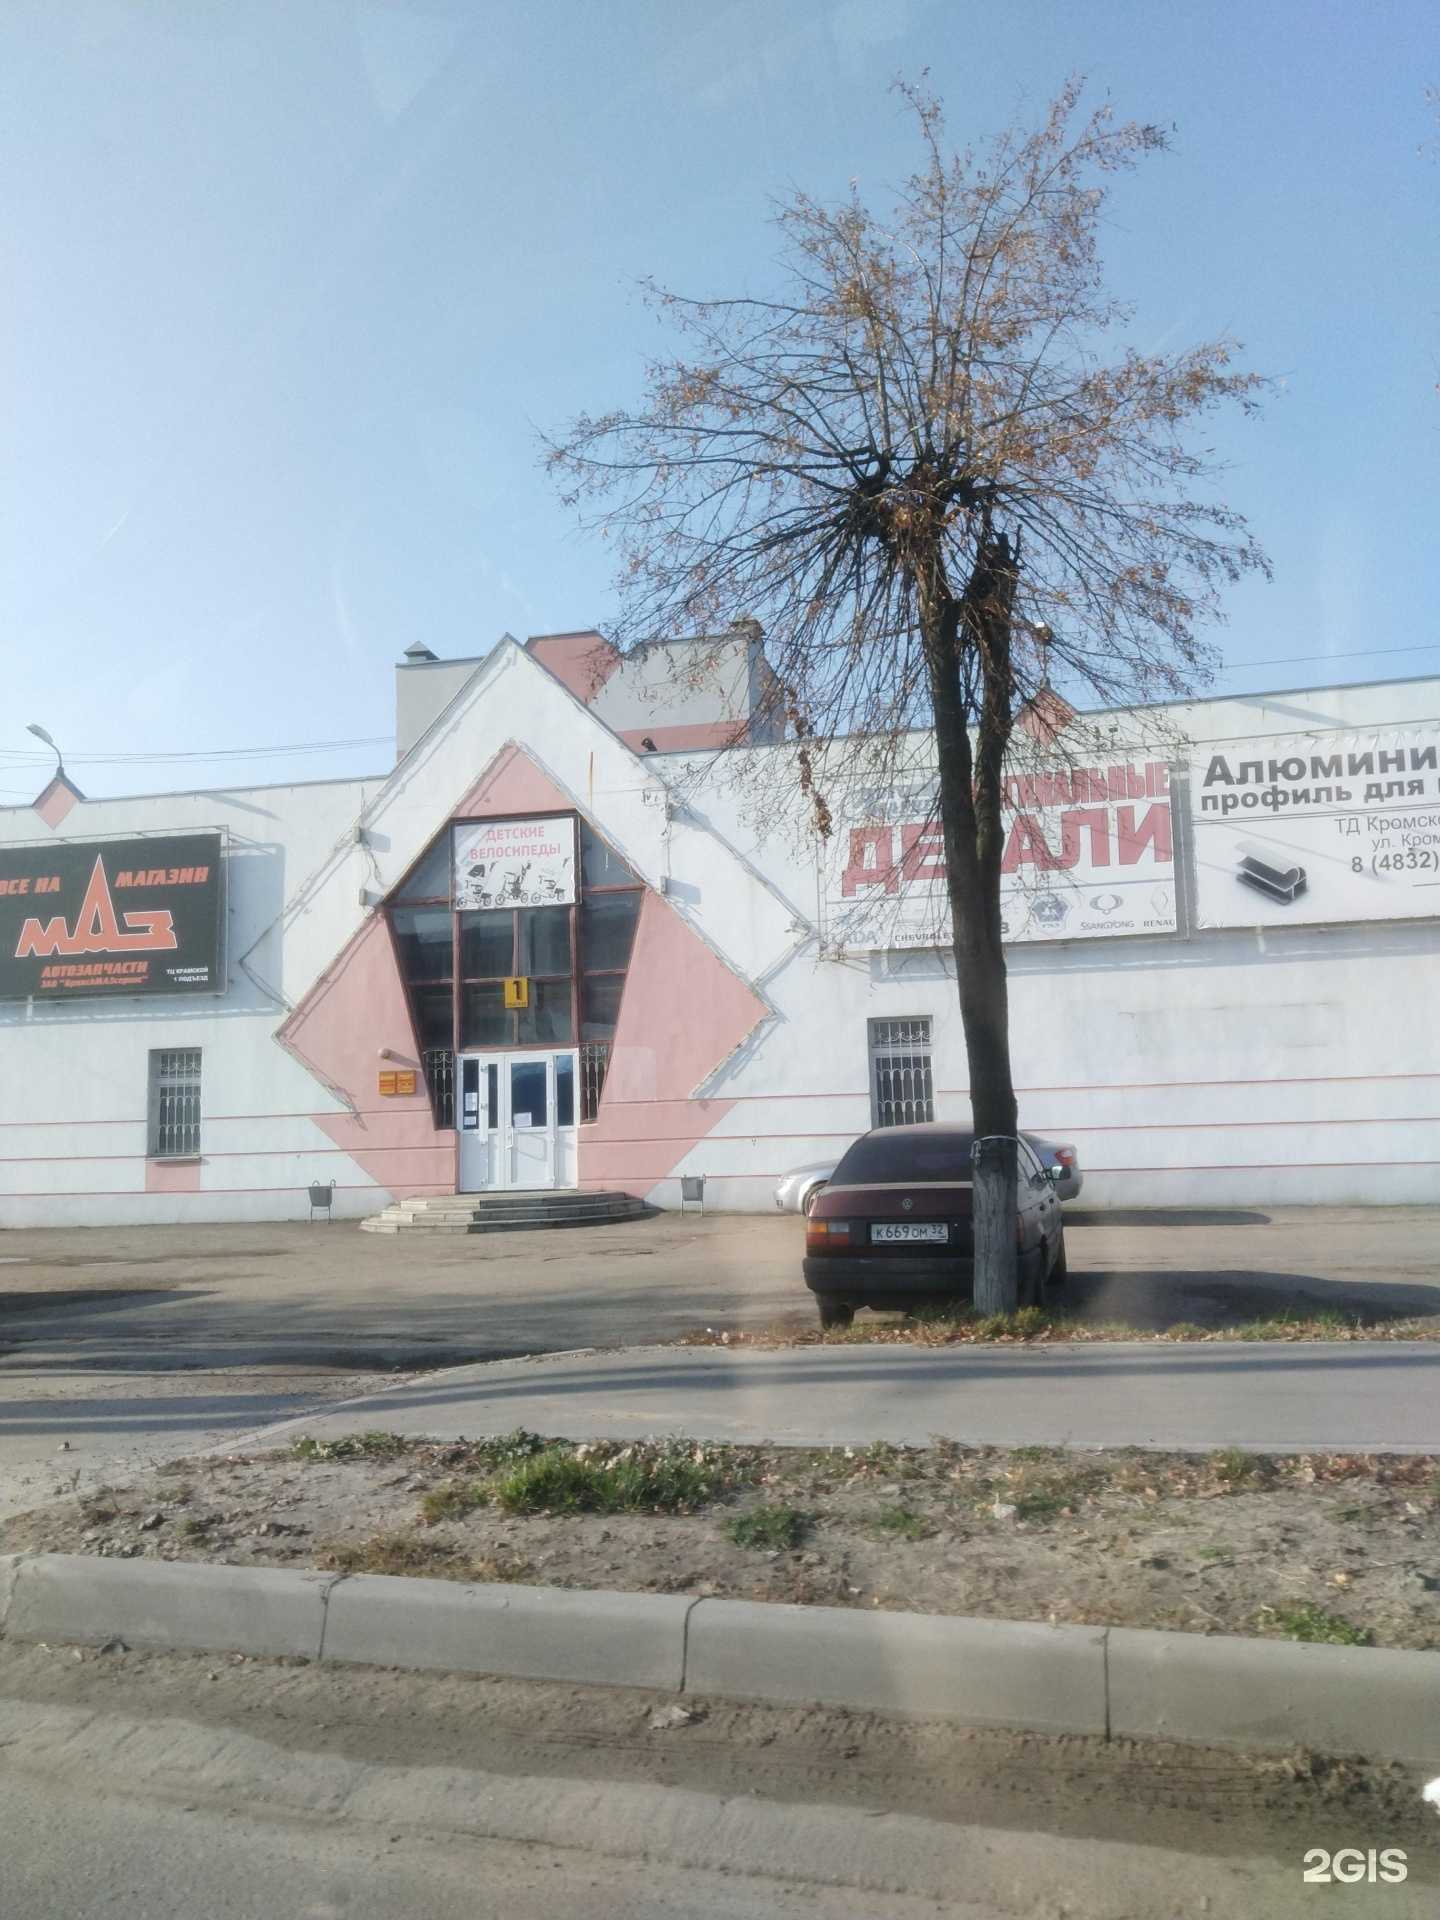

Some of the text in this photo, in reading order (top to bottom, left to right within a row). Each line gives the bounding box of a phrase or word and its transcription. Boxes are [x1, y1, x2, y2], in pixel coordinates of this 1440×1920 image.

[1203, 746, 1437, 787] Алюмини
[1201, 785, 1352, 815] профиль
[1364, 778, 1425, 803] для
[486, 826, 545, 842] ДЕТСКИЕ
[1334, 815, 1440, 836] ТД Кромск
[469, 843, 561, 860] ВЕЛОСИПЕДЫ
[841, 802, 1173, 898] ДЕАЛИ
[1372, 838, 1398, 852] ул.
[1351, 850, 1439, 876] 8 (4832)
[34, 876, 61, 894] НА
[114, 866, 209, 888] МАГАЗИН
[15, 853, 178, 957] МАЗ
[895, 932, 953, 943] CHEVROLE
[41, 961, 149, 978] АВТОЗАПЧАСТИ
[513, 980, 522, 1000] 1
